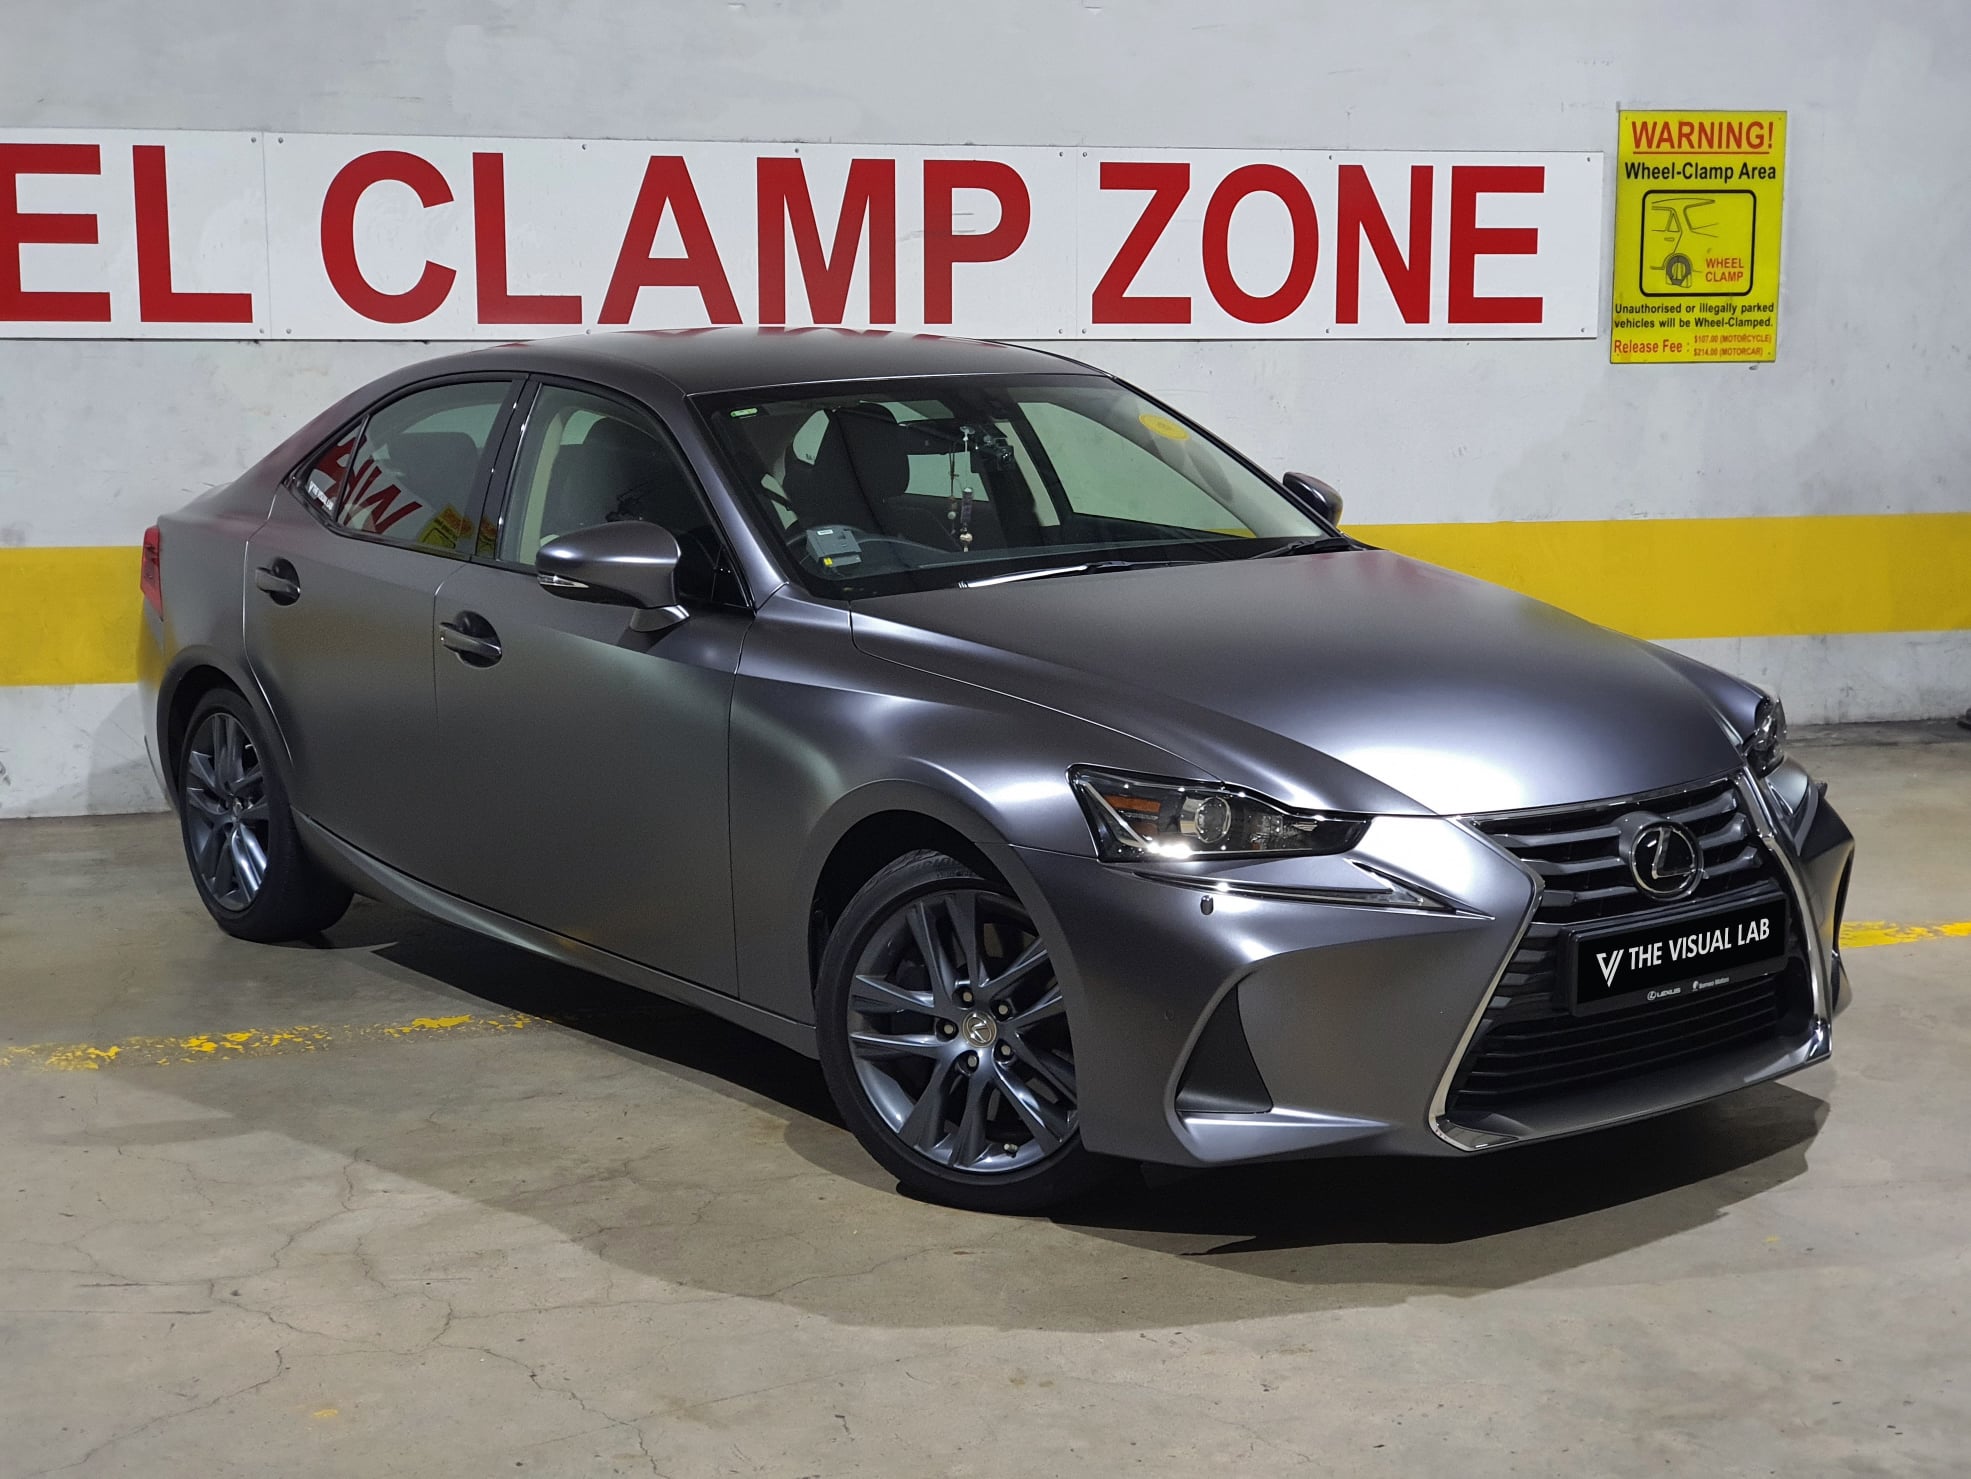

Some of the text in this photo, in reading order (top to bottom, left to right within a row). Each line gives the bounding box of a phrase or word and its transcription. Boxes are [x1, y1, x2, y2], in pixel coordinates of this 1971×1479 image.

[1631, 120, 1774, 149] WARNING!
[1625, 161, 1776, 184] Wheel-Clamp Area
[320, 151, 1031, 325] CLAMP
[1091, 162, 1546, 325] ZONE
[1705, 257, 1744, 269] WHEEL
[1705, 271, 1744, 282] CLAMP
[1614, 302, 1774, 315] Unauthorised or illegally parked
[1614, 317, 1773, 329] vehicles will be Wheel-Clamped.
[1614, 339, 1658, 353] Release
[1663, 339, 1683, 353] Fee
[1628, 941, 1664, 970] THE
[1669, 927, 1732, 961] VISUAL
[1737, 918, 1770, 945] LAB
